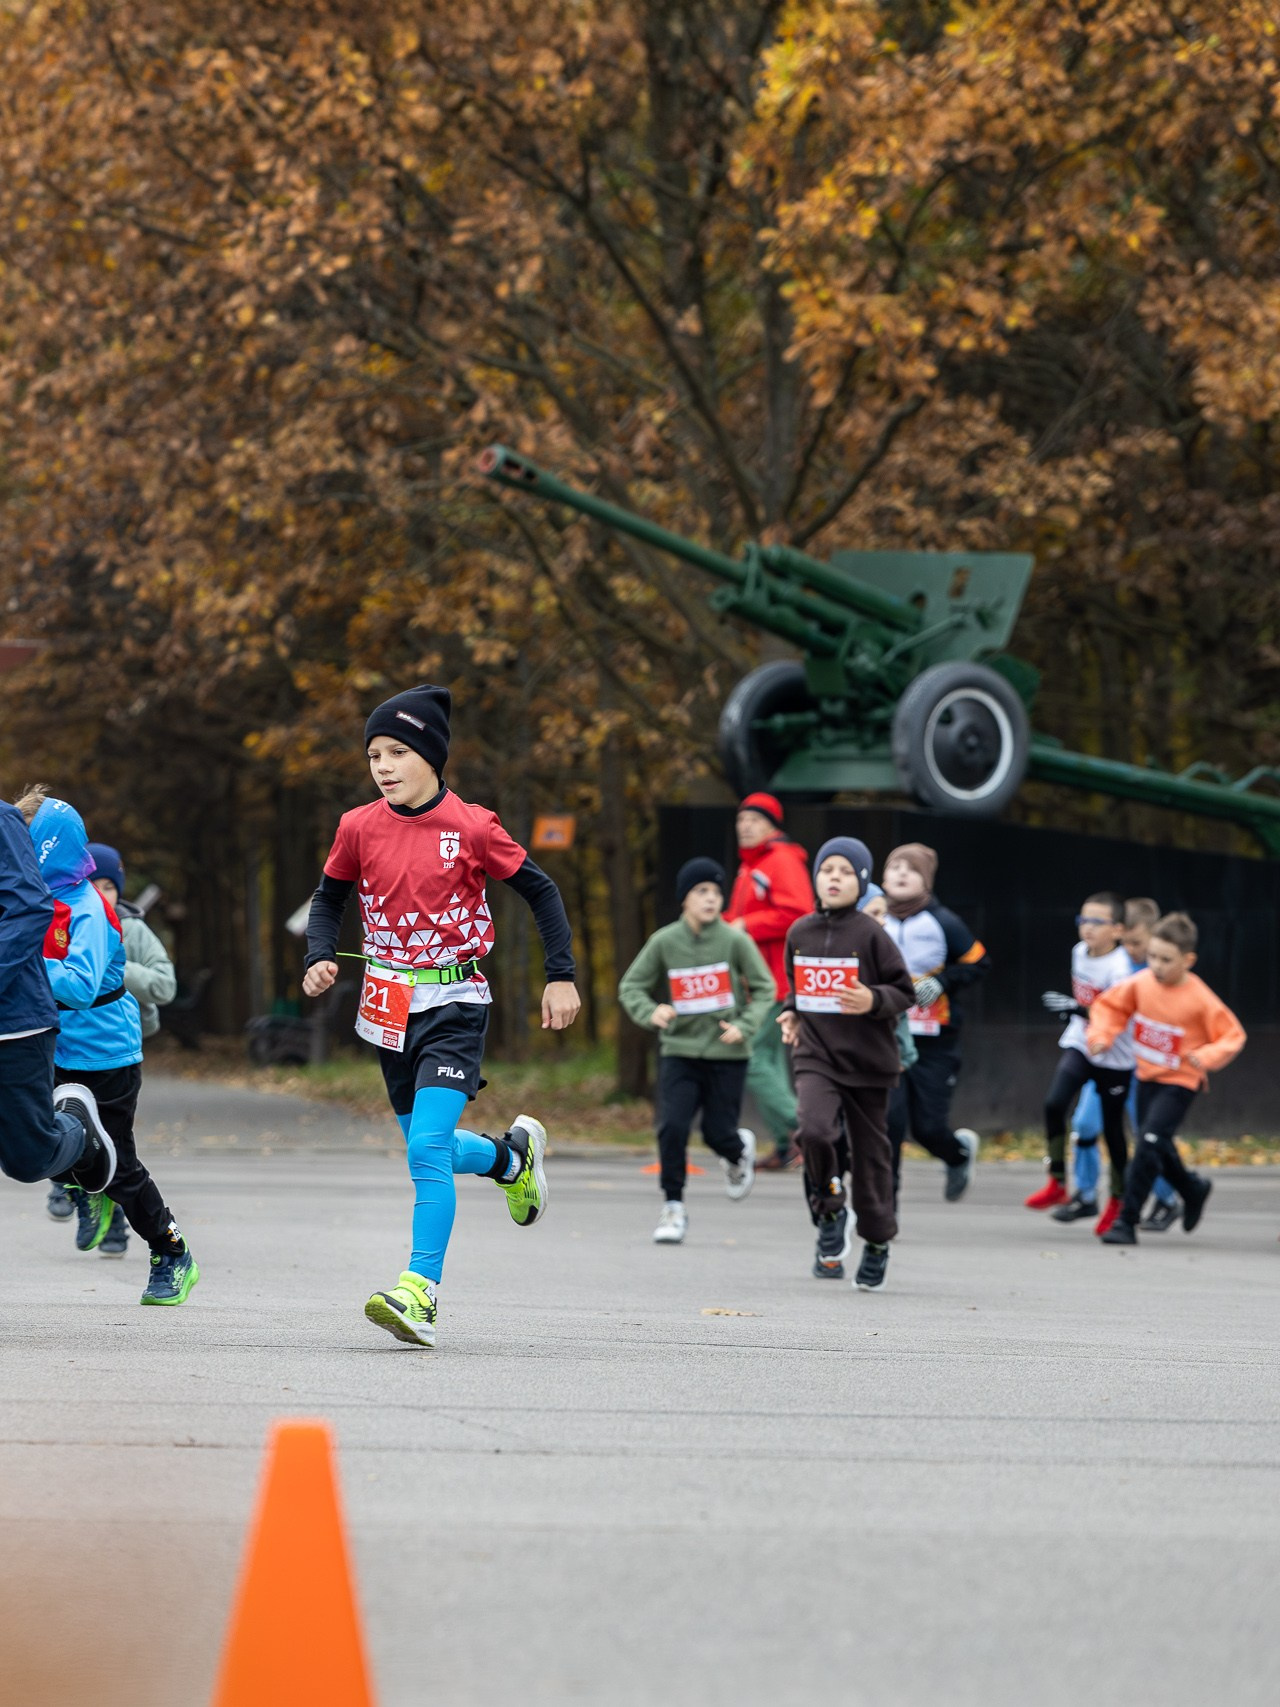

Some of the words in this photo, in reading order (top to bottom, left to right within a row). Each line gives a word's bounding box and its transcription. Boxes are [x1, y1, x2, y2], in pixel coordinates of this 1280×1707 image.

[679, 973, 720, 999] 310
[803, 967, 846, 993] 302
[437, 1066, 466, 1080] FILA
